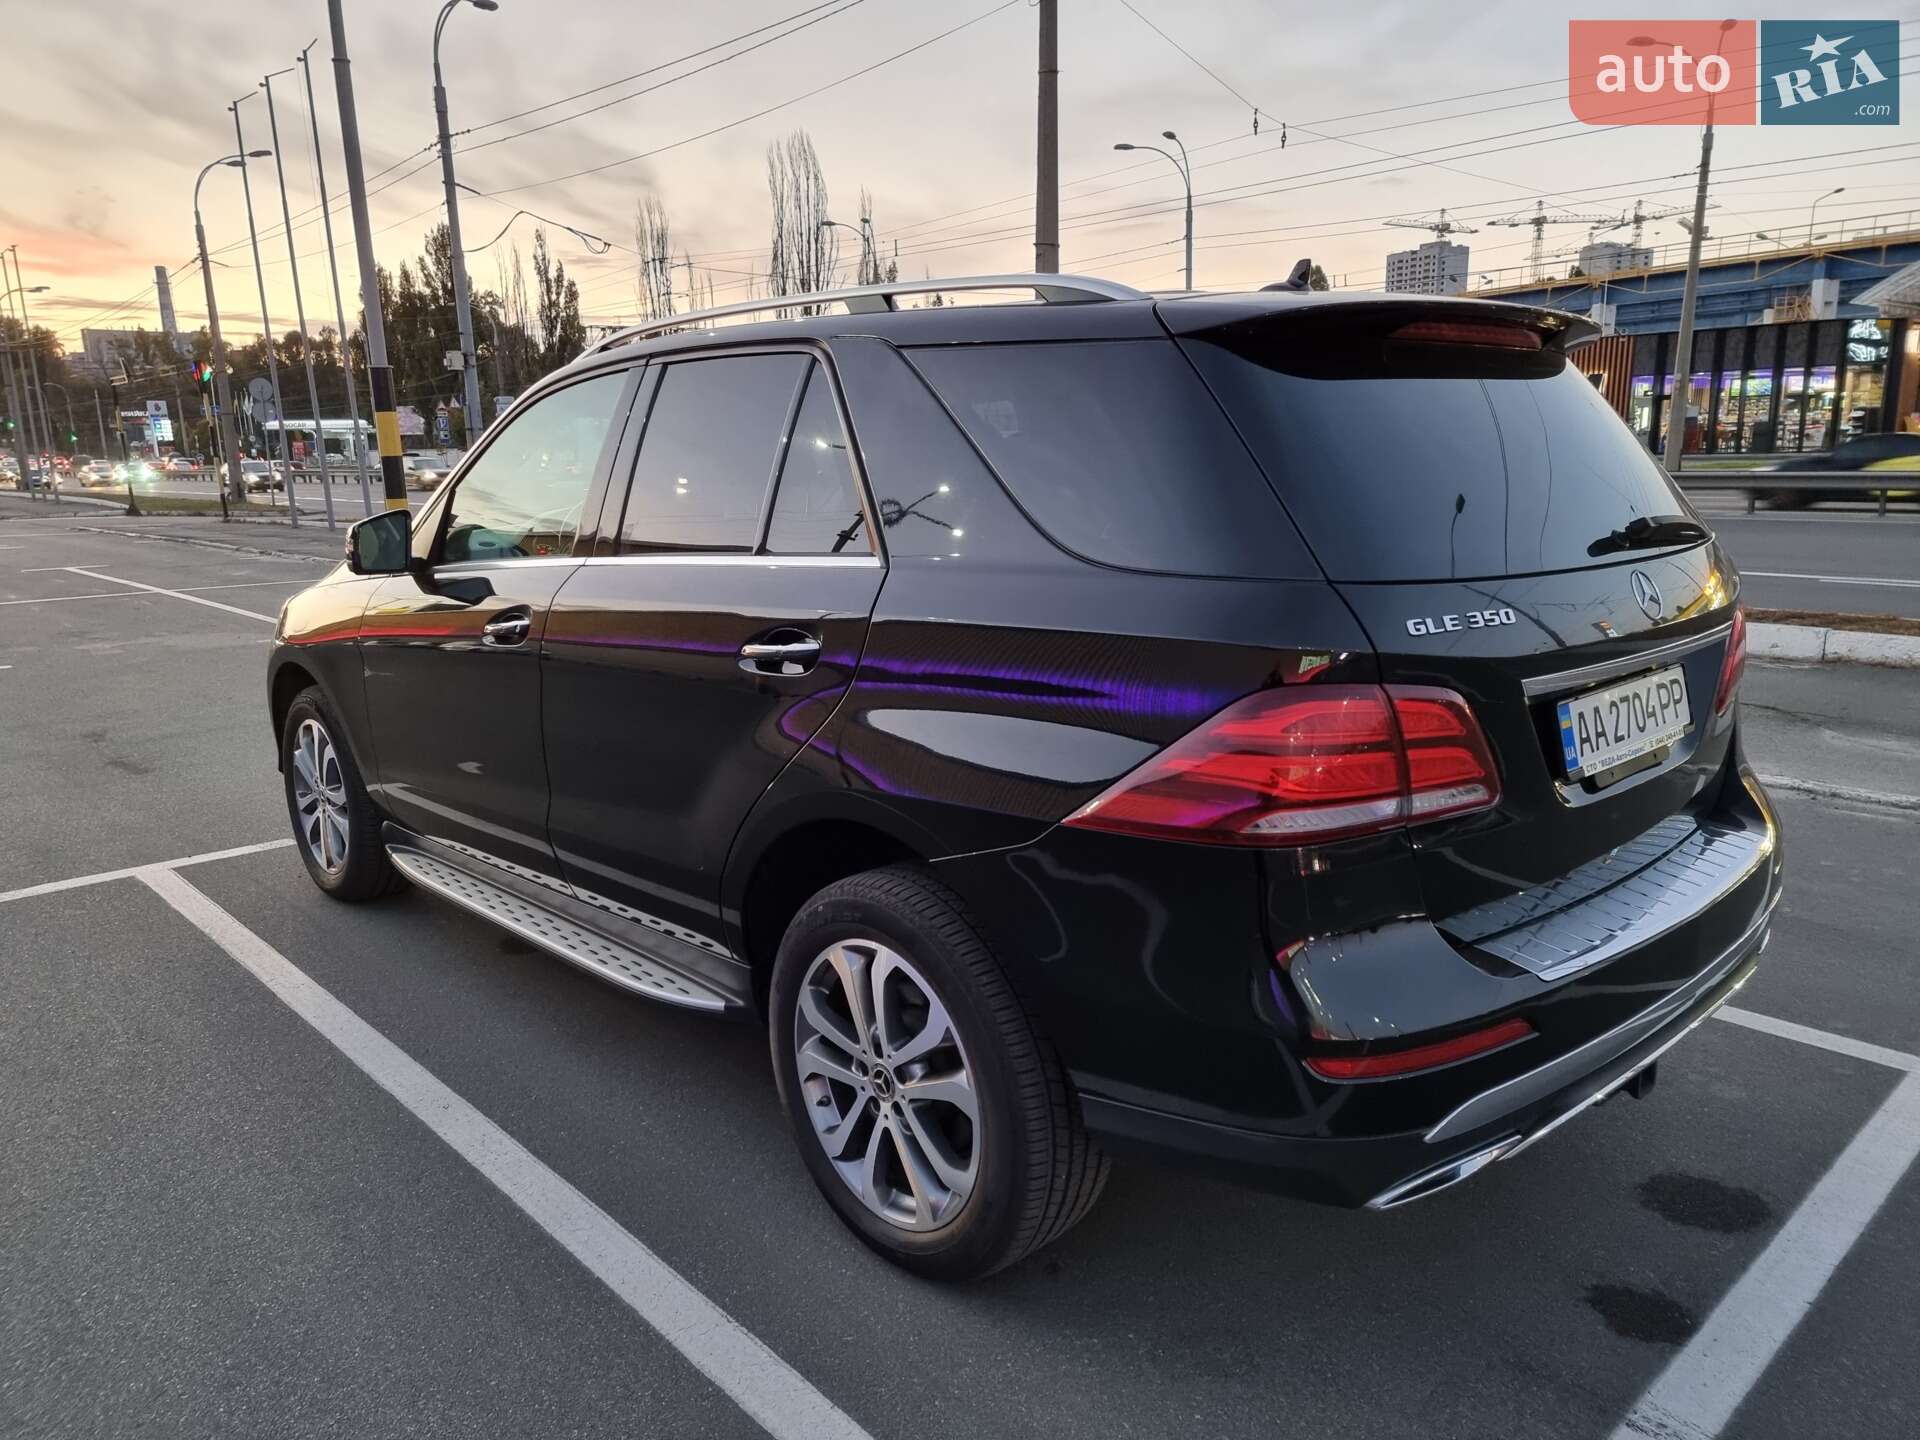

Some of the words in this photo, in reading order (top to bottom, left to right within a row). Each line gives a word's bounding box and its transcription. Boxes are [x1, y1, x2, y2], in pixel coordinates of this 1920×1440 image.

[1406, 614, 1462, 636] GLE
[1466, 608, 1516, 628] 350
[1566, 747, 1577, 760] UA
